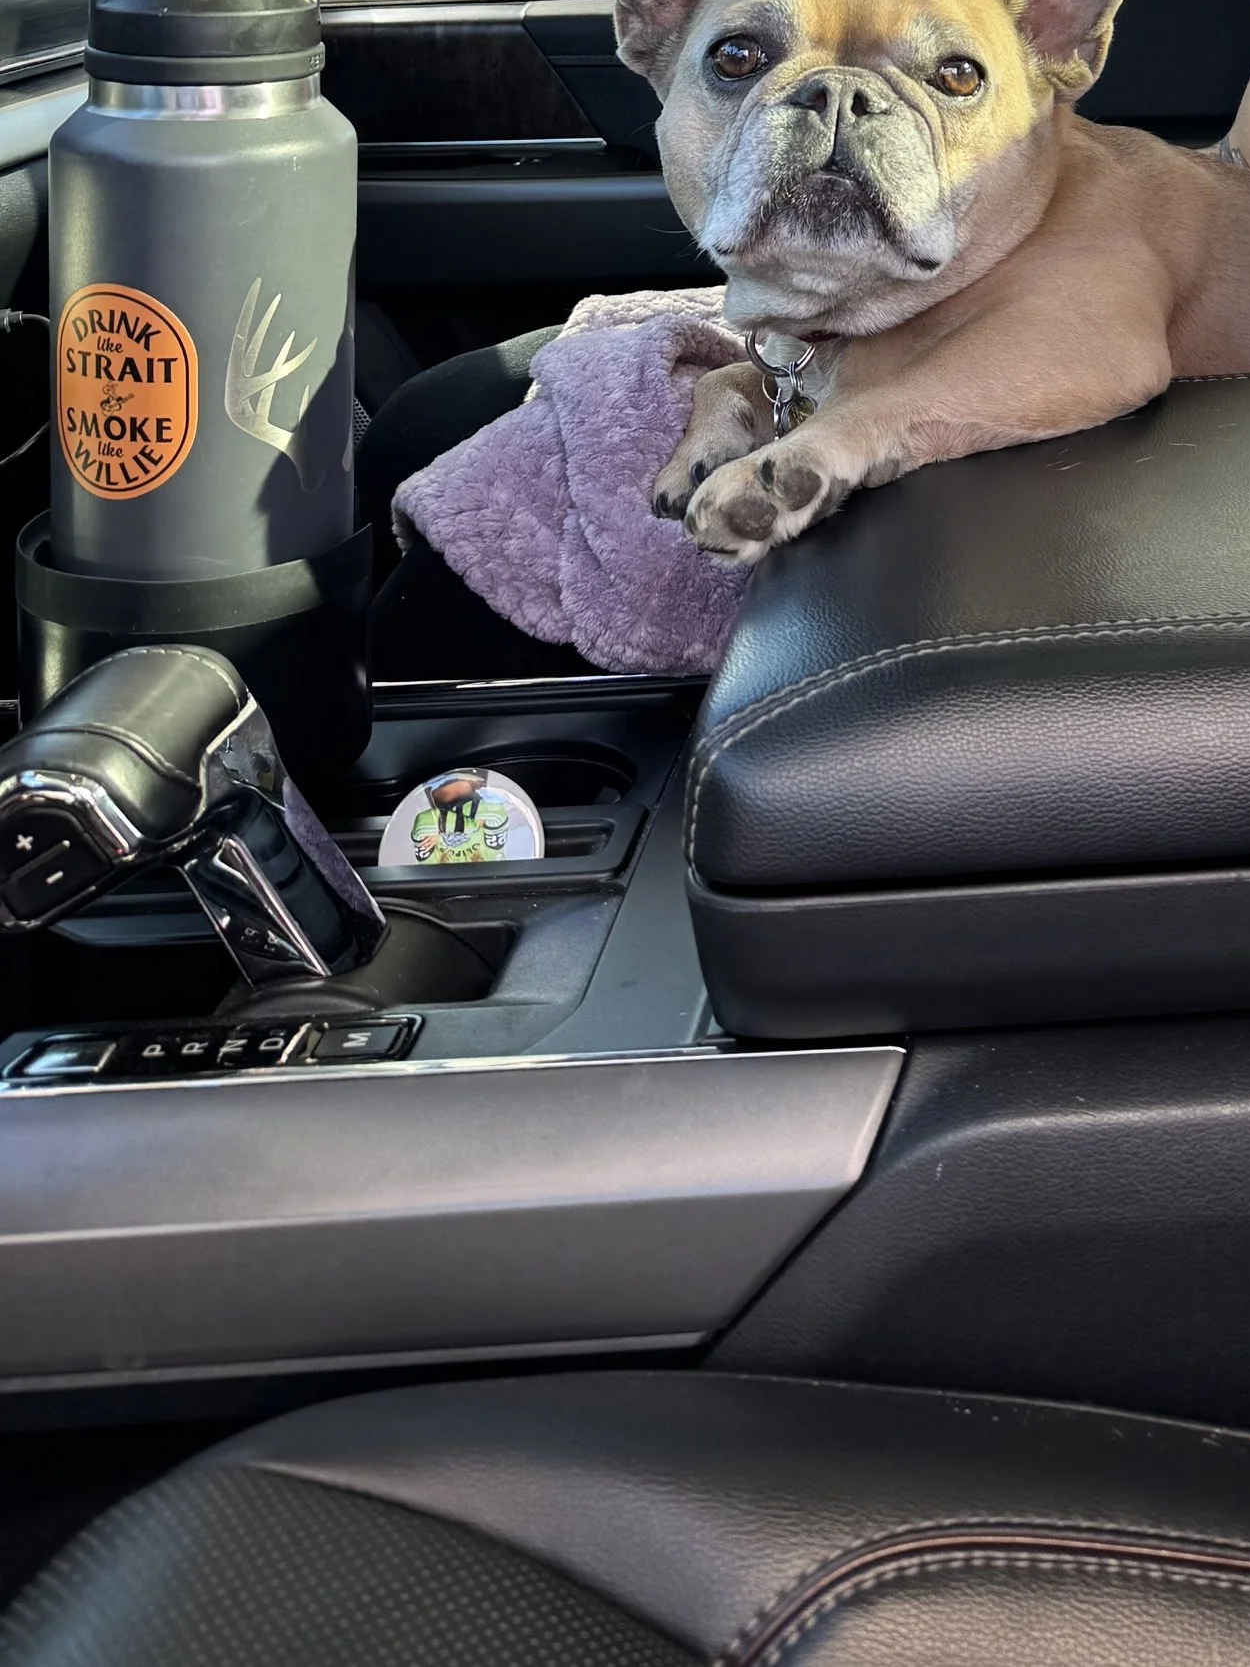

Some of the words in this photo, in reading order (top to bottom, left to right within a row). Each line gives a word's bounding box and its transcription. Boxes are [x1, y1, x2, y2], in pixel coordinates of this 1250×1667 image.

[71, 309, 161, 352] DRINK
[97, 336, 124, 353] like
[66, 348, 179, 384] STRAIT
[66, 407, 173, 443] SMOKE
[74, 439, 164, 486] WILLIE
[98, 440, 124, 458] like
